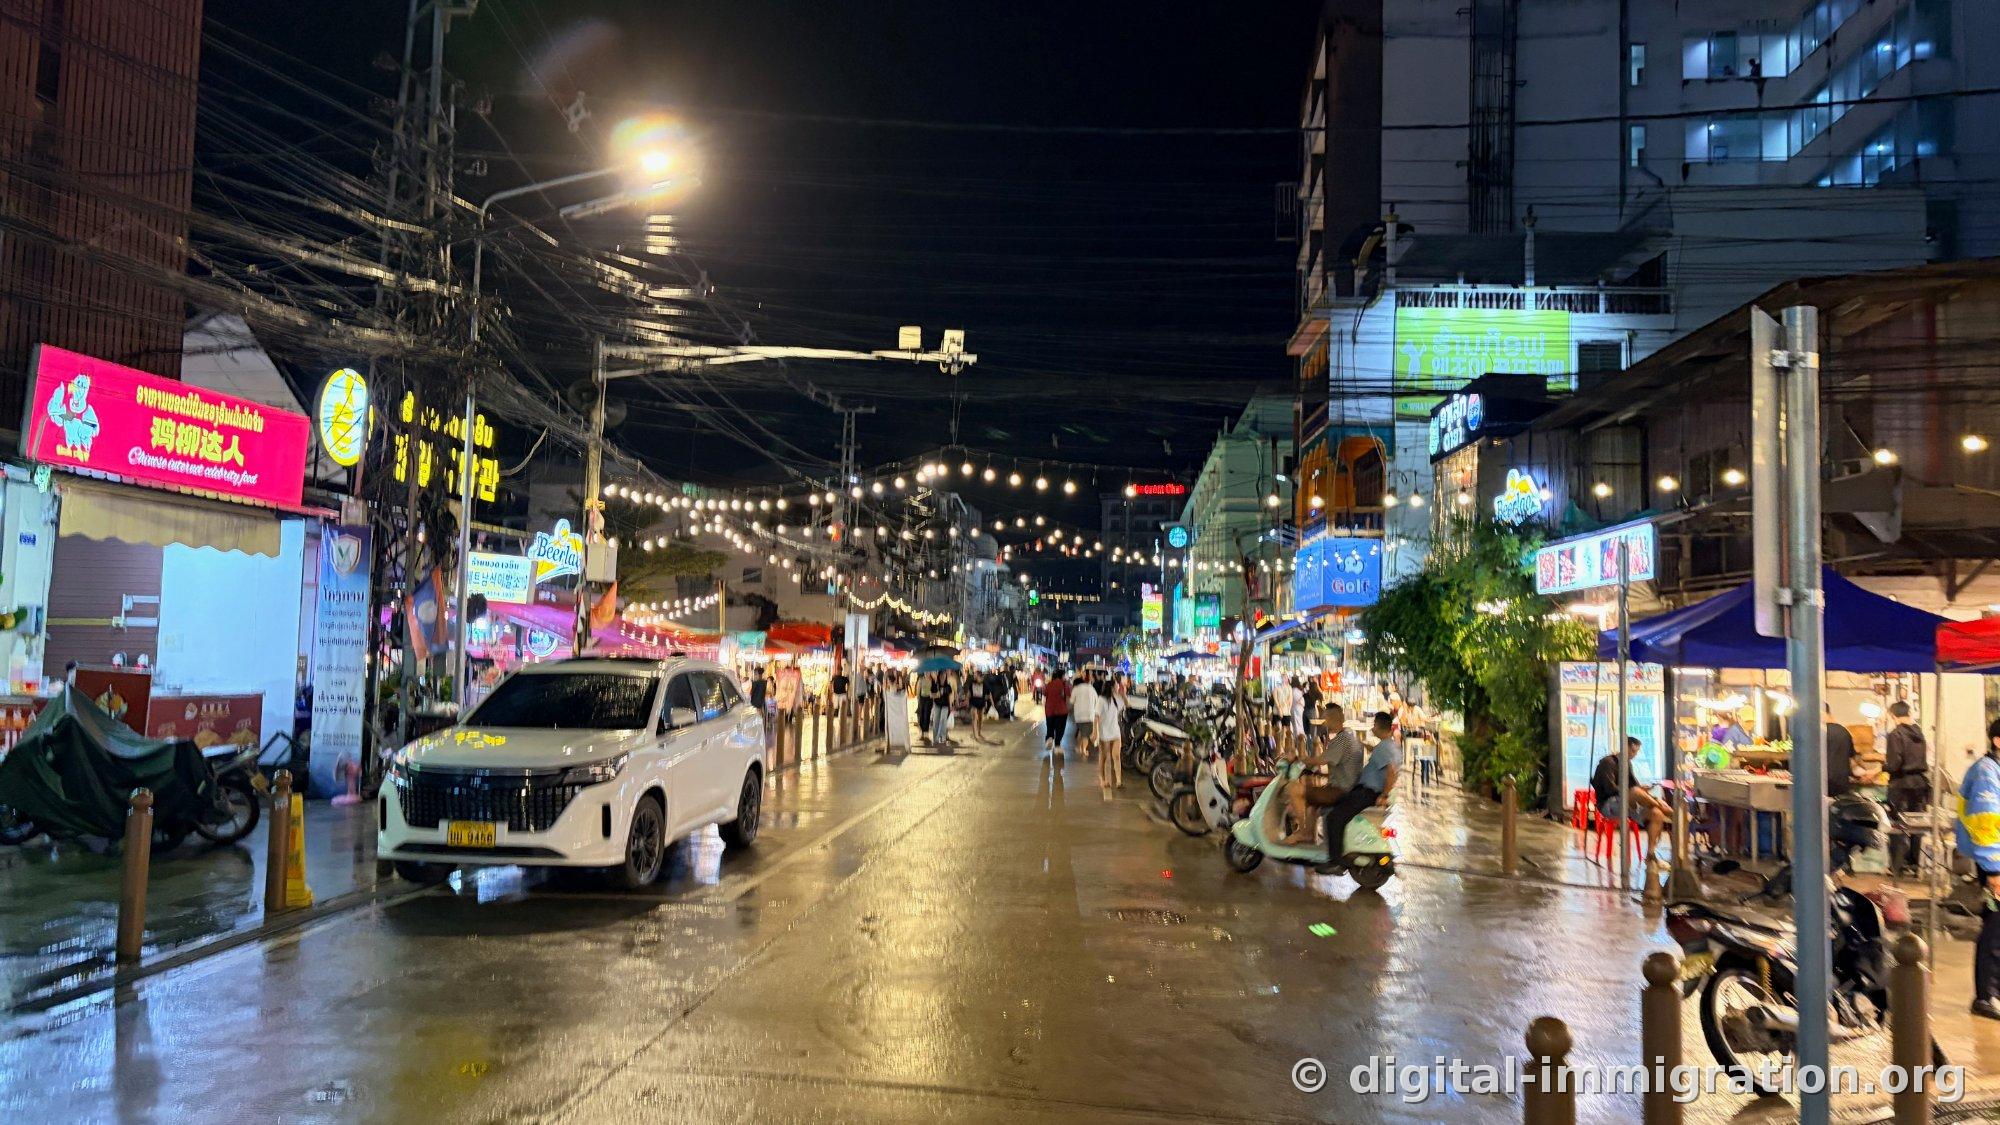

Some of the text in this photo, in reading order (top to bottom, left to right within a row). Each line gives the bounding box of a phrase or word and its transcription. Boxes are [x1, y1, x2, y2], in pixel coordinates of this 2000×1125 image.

[150, 416, 245, 467] 鸡柳达人
[128, 446, 168, 469] Chinese
[204, 465, 240, 485] celebrity
[237, 470, 258, 487] food
[1331, 577, 1370, 595] Golf
